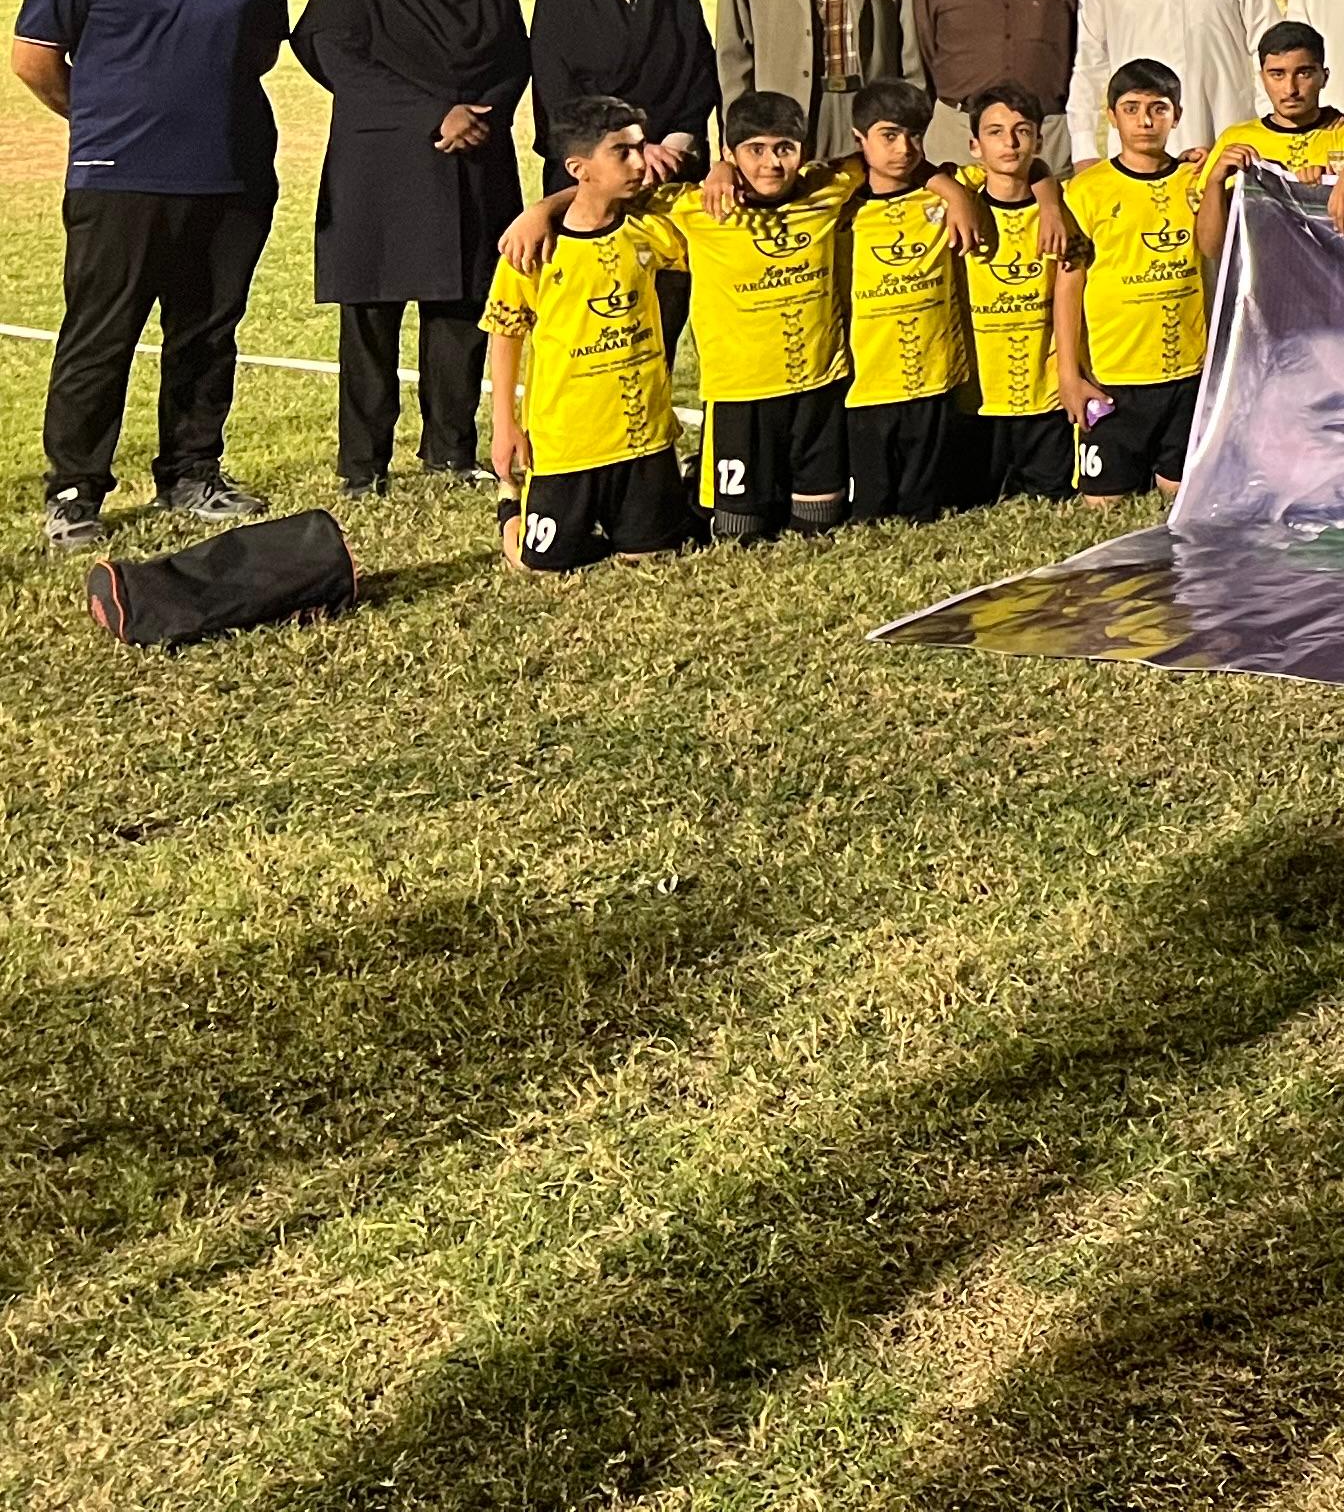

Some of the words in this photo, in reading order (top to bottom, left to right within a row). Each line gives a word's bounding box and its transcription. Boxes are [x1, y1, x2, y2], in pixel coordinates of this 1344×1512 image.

[855, 284, 907, 300] VARGAAR
[1121, 272, 1173, 285] VARGAAR
[718, 458, 746, 495] 12
[1078, 441, 1103, 477] 16
[525, 512, 556, 553] 19
